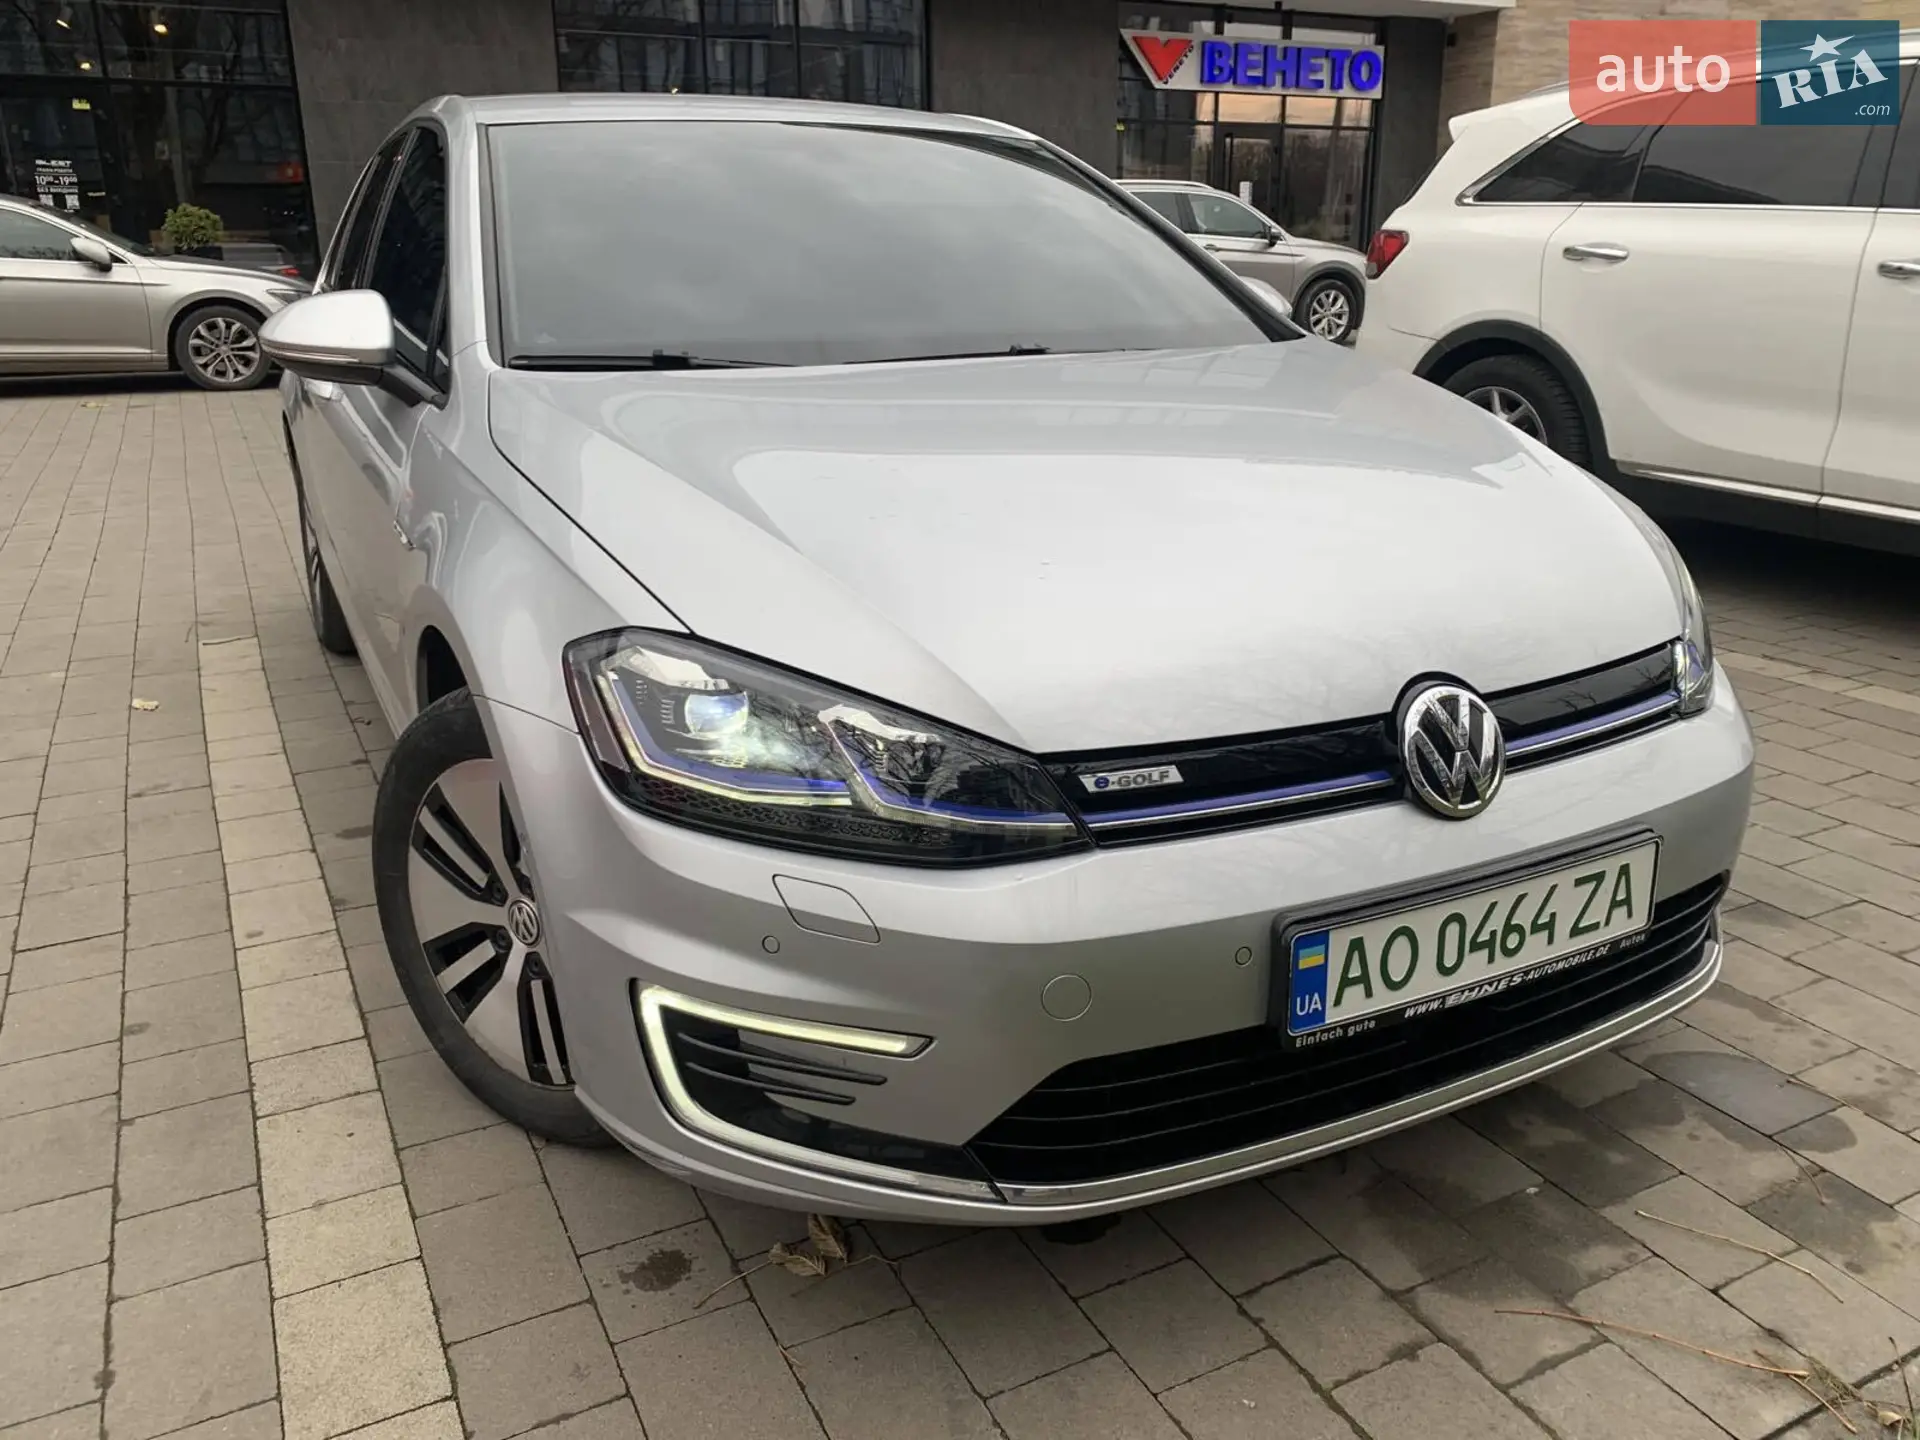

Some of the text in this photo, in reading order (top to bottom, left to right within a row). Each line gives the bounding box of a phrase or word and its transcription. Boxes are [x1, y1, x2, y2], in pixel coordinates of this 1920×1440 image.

[1201, 40, 1382, 92] ВЕНЕТО
[1333, 862, 1634, 1008] AO 0464 ZA
[1296, 992, 1323, 1016] UA
[1295, 1026, 1344, 1048] Einfach
[1347, 1019, 1377, 1037] gute
